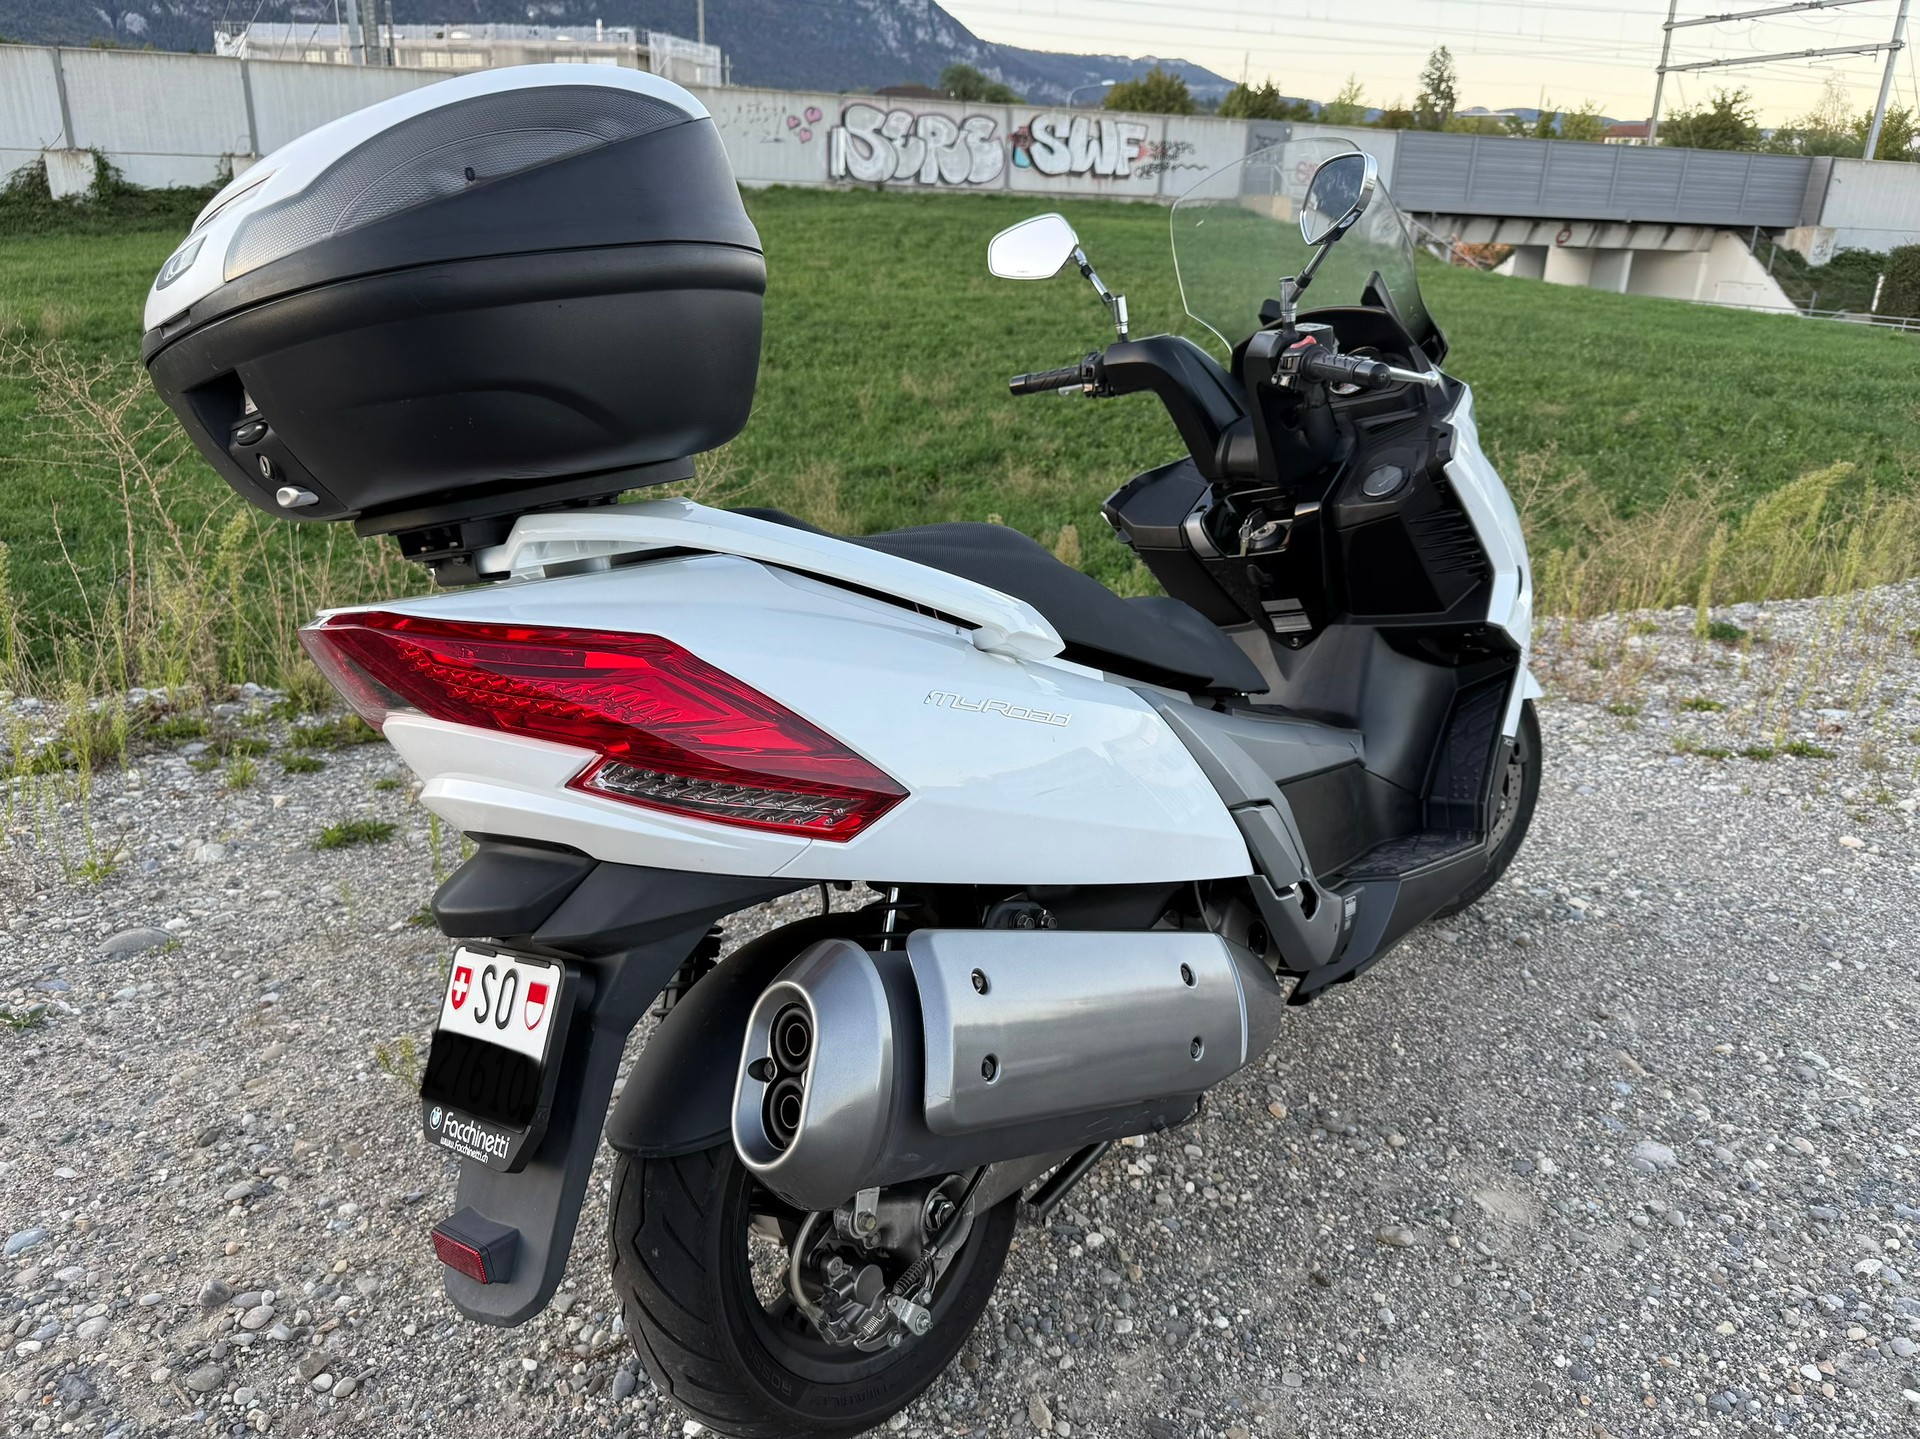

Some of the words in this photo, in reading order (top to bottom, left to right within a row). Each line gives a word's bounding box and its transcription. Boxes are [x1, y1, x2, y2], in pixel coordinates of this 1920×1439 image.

[1029, 112, 1149, 178] SWF
[923, 690, 1073, 727] MyRoad
[474, 964, 519, 1030] SO
[442, 1111, 511, 1159] Facchinetti
